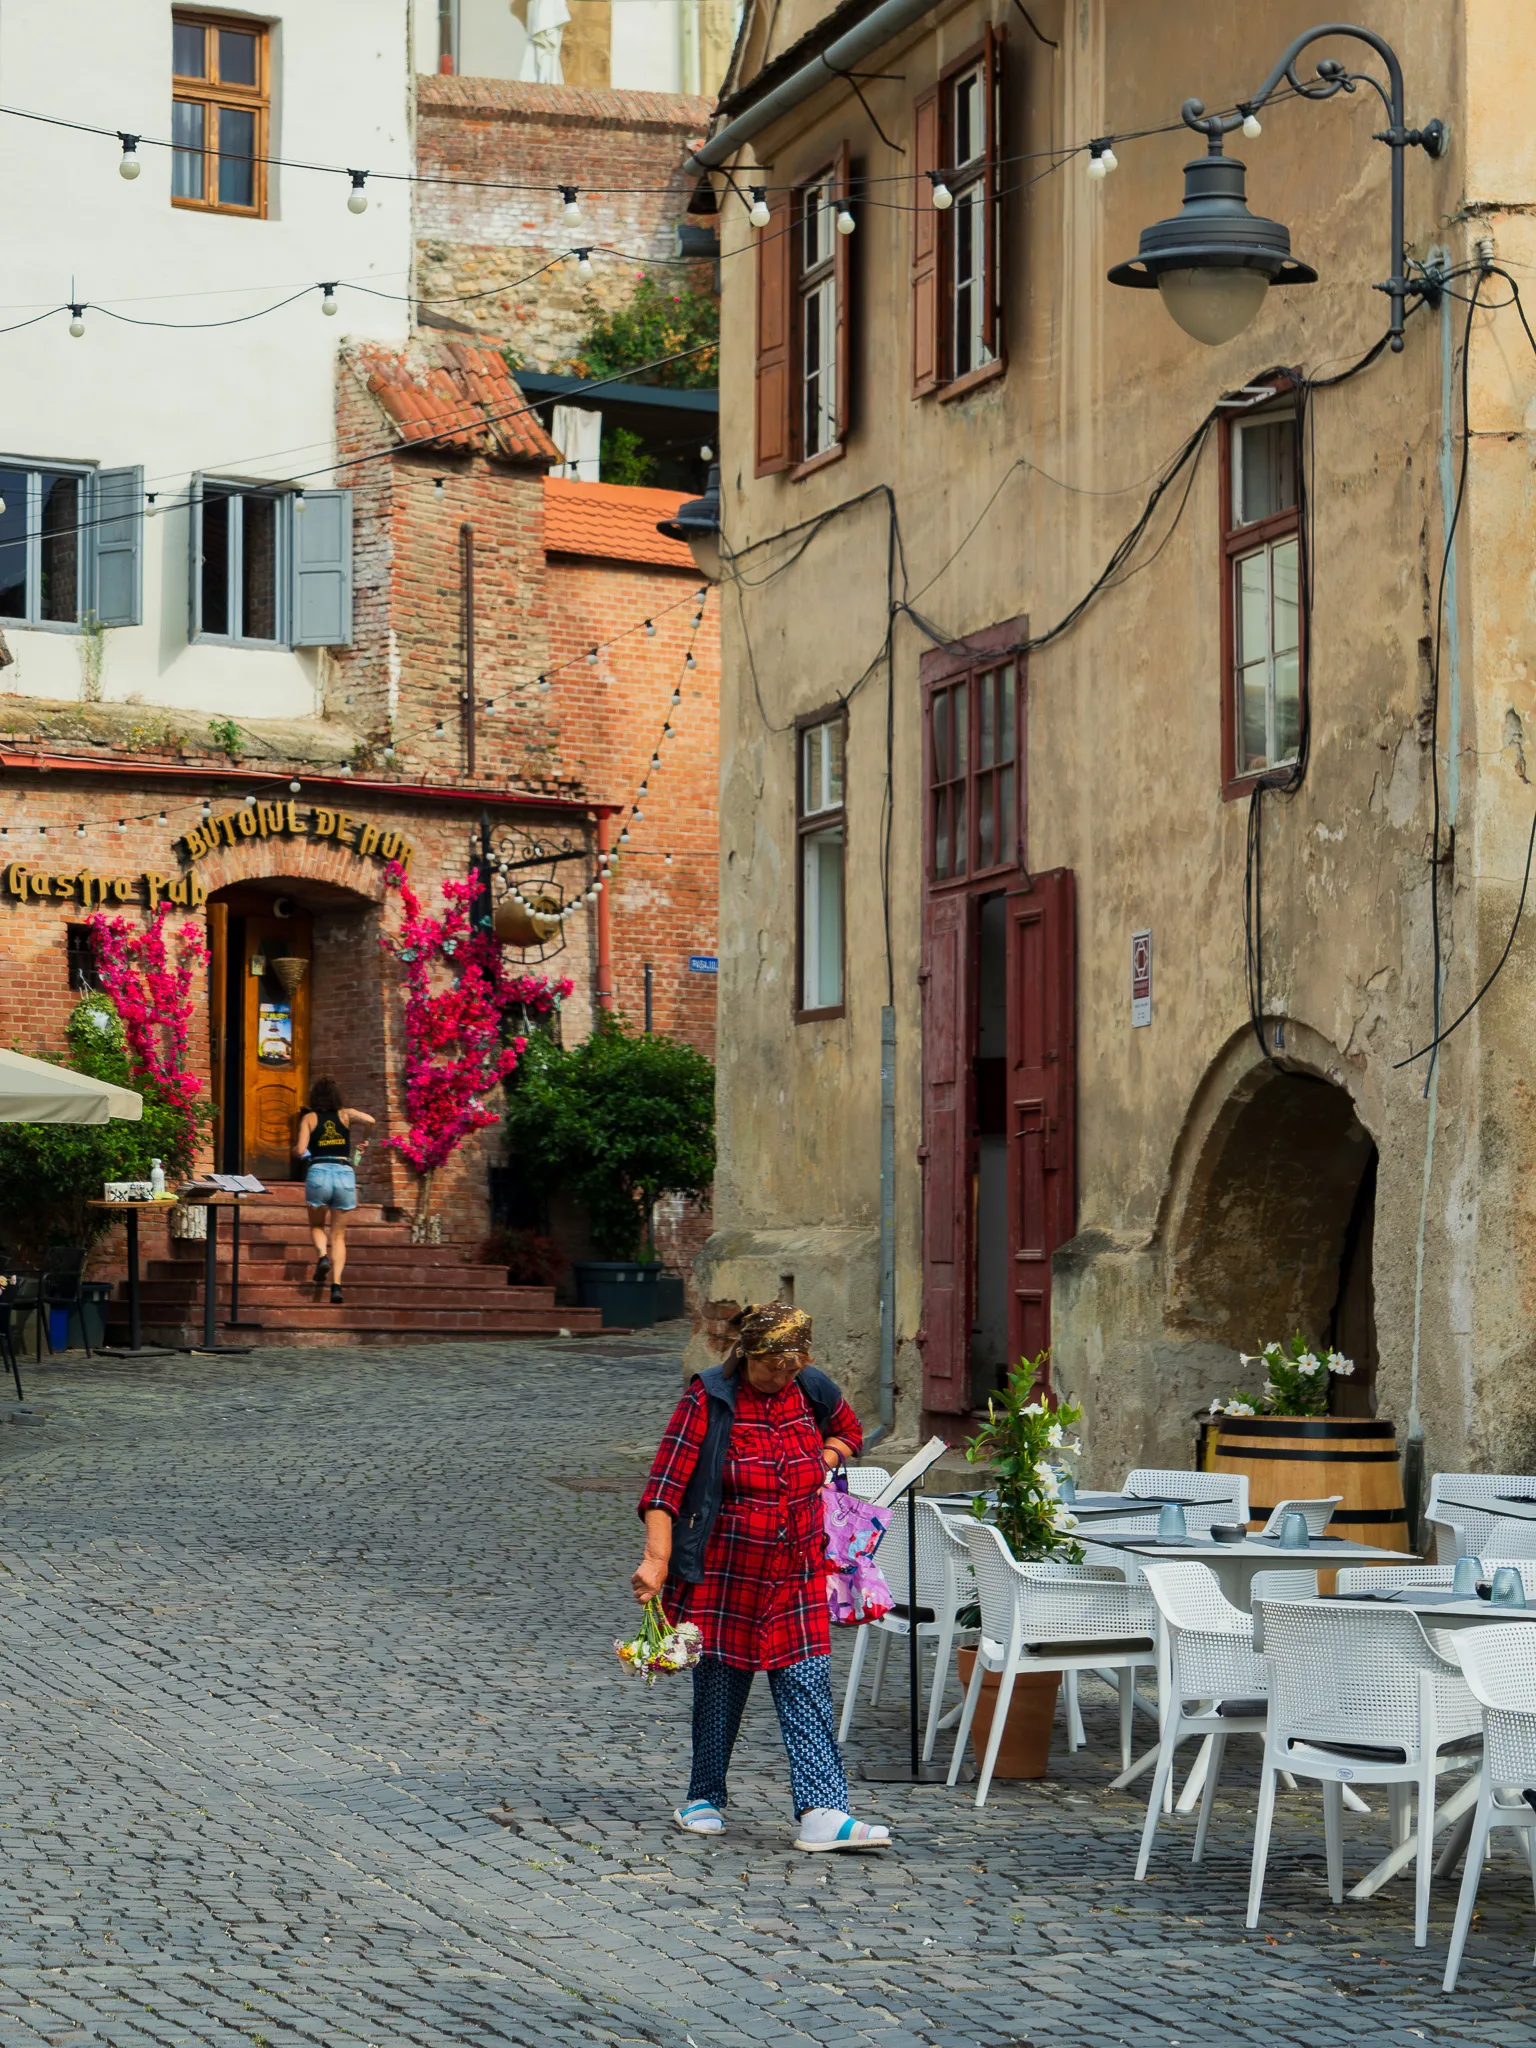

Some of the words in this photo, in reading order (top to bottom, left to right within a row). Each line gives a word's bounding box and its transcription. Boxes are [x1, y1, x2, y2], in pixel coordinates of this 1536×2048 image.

[183, 799, 306, 861] BUTOIUL
[314, 807, 356, 842] DE
[358, 823, 415, 874] AUR
[8, 862, 133, 908] Gastro
[146, 870, 209, 911] Pub
